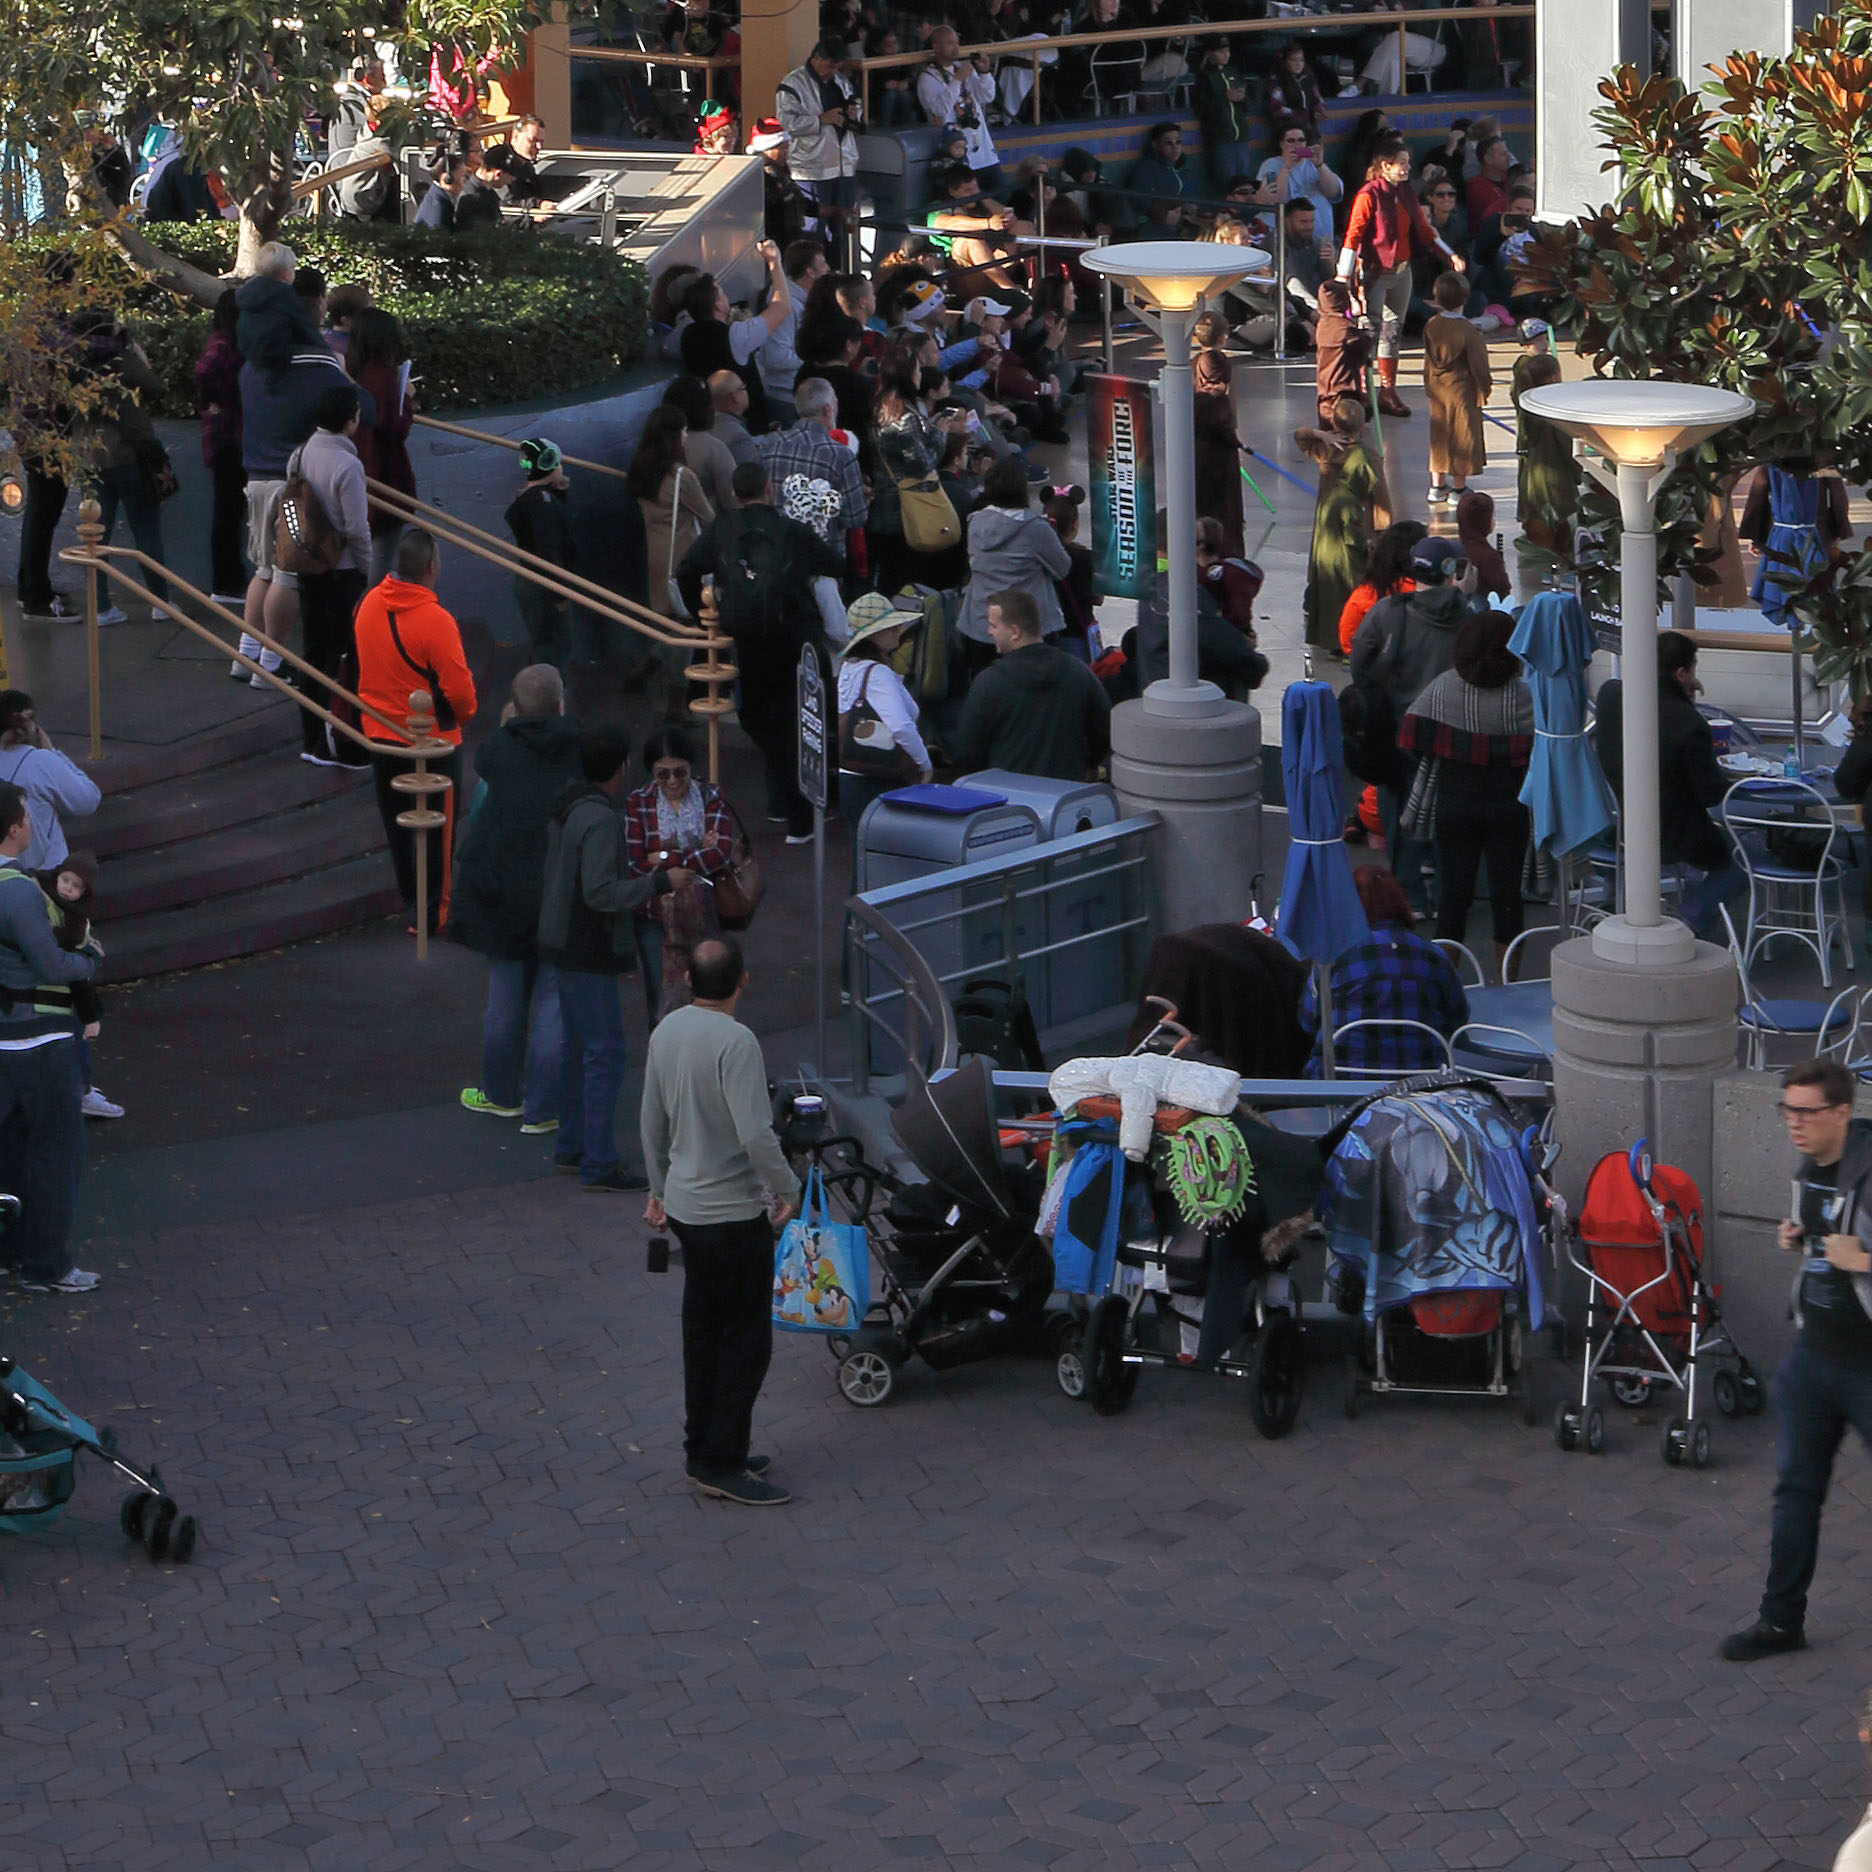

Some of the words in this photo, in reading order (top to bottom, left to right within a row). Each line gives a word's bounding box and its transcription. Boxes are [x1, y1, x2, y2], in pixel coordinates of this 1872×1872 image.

[1107, 445, 1116, 483] WARS
[1108, 484, 1118, 525] STAR
[1118, 487, 1136, 582] SEASON
